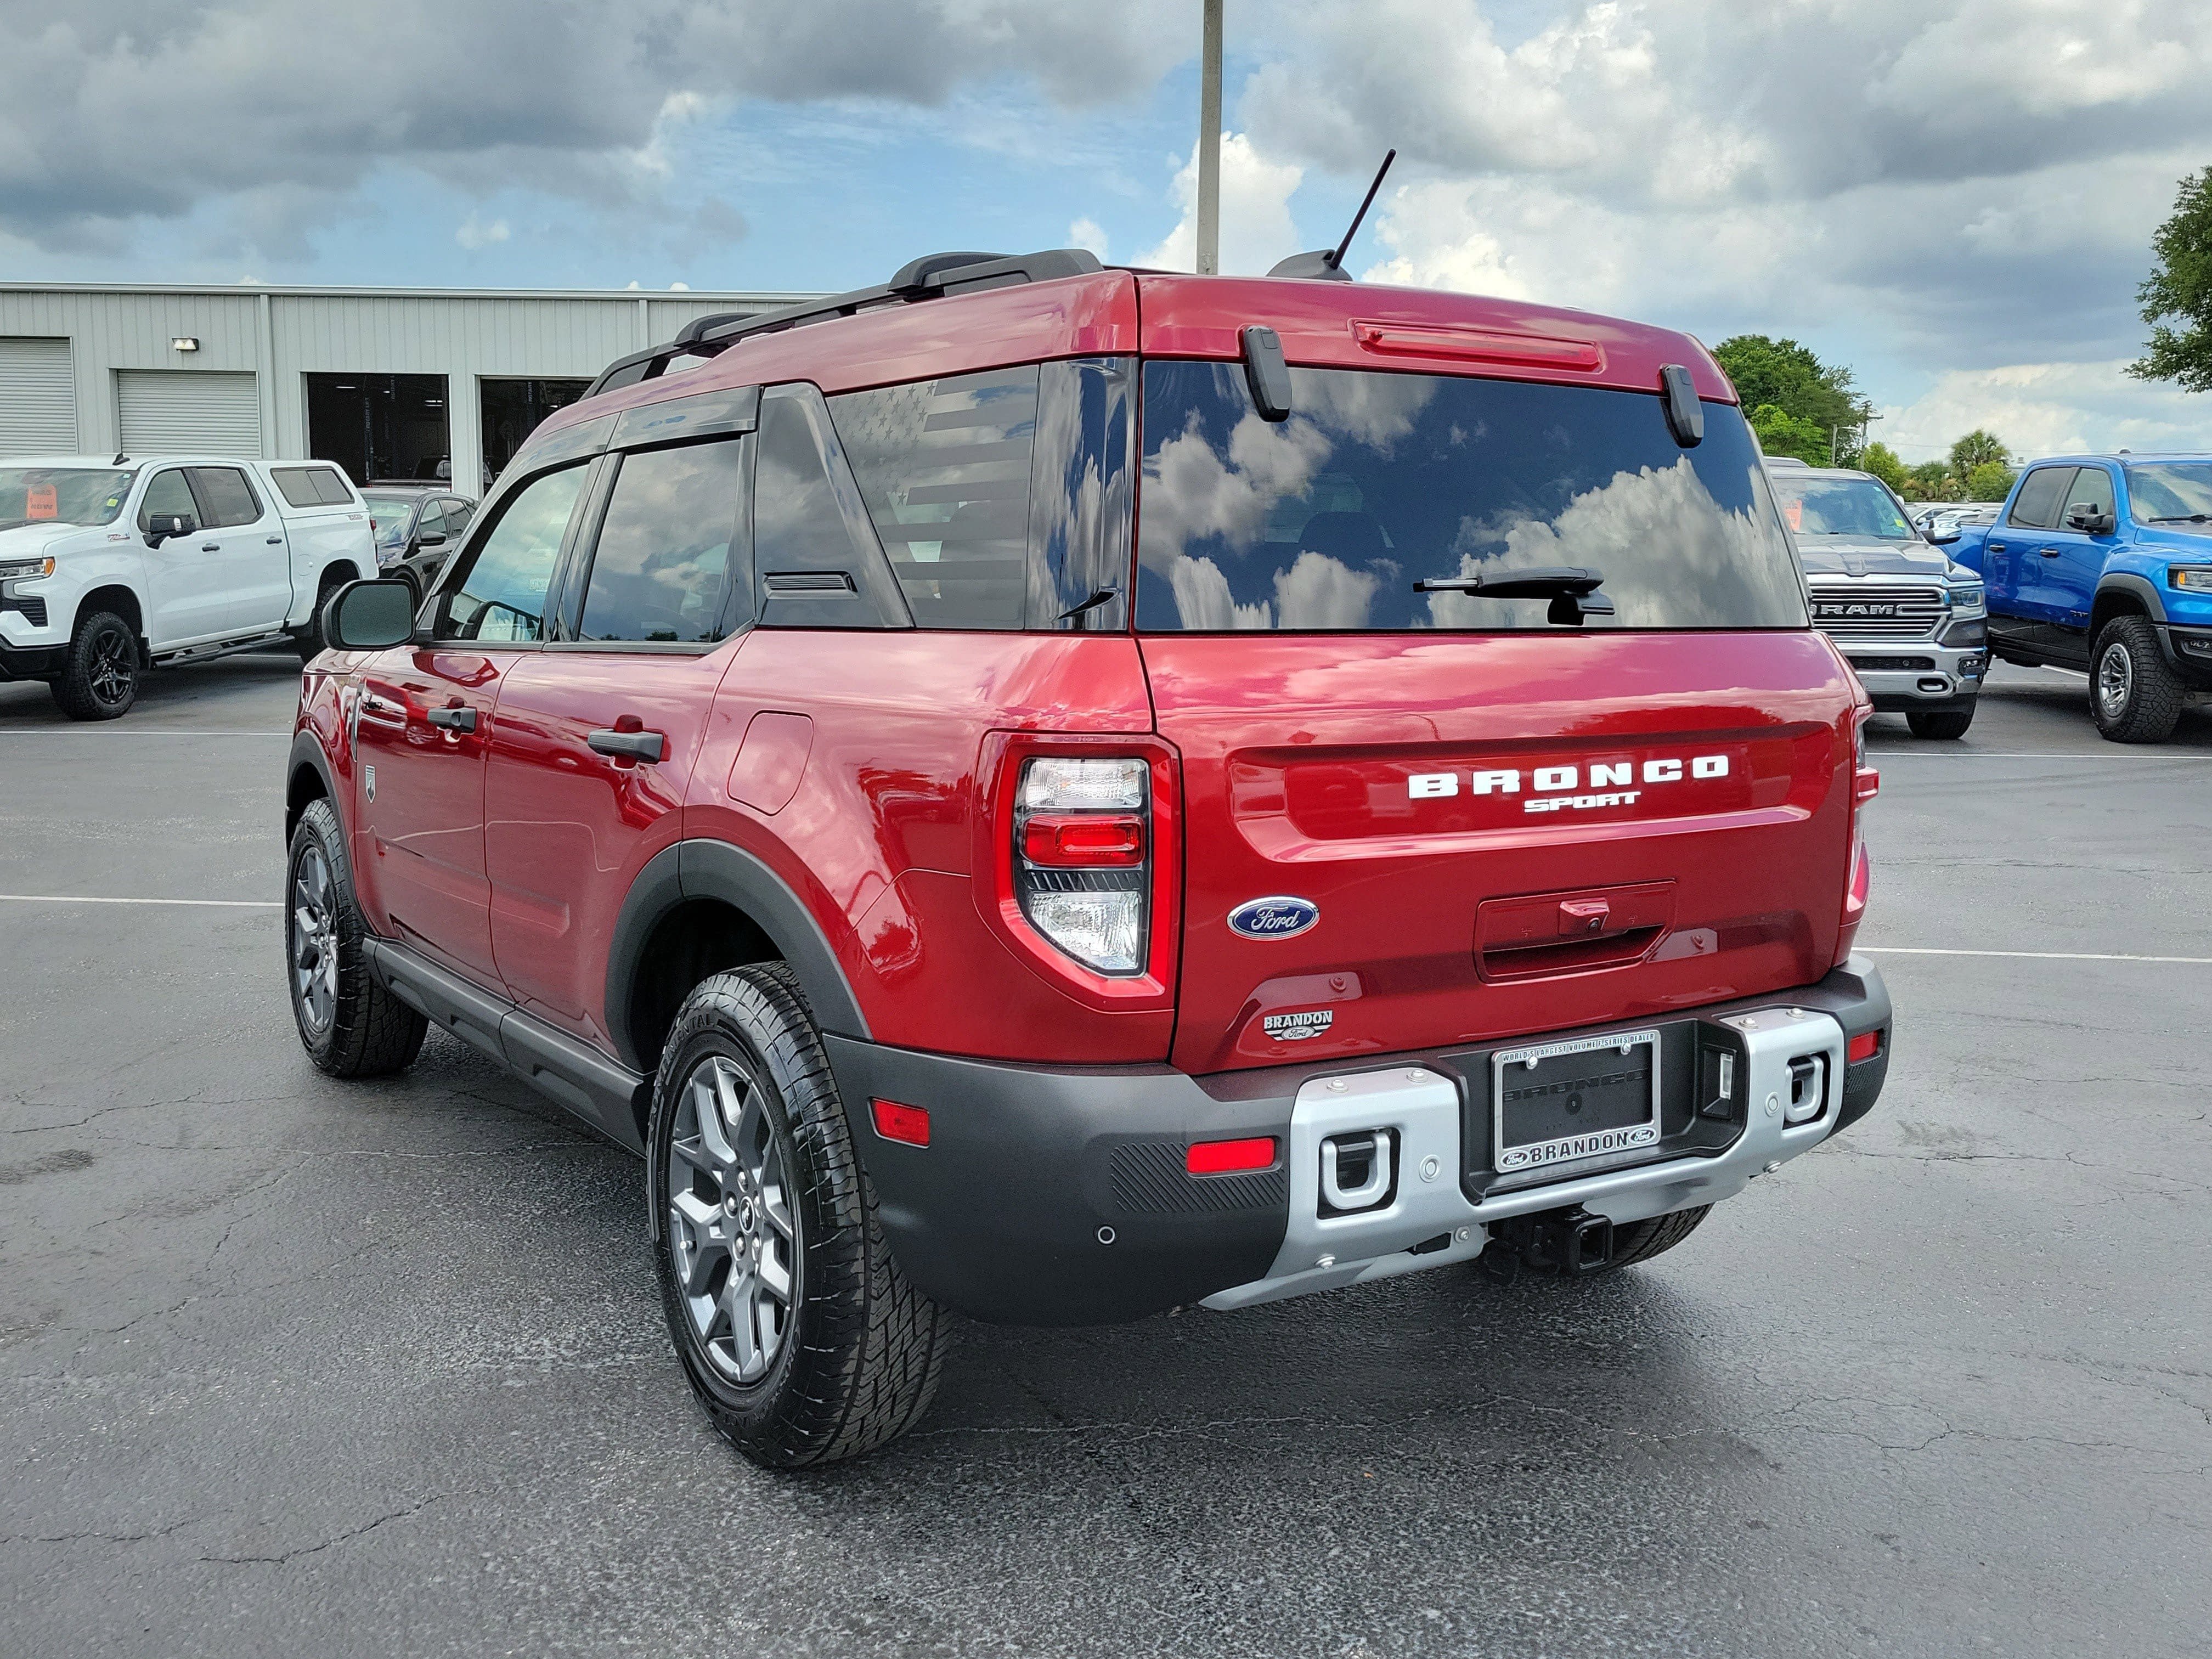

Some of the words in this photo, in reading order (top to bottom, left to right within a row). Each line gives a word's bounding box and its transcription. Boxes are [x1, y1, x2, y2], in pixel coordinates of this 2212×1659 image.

[1821, 605, 1894, 615] RAM
[1408, 755, 1729, 799] BRONCO
[1524, 792, 1641, 812] SPORT
[1251, 906, 1300, 930] Ford
[1264, 1011, 1332, 1029] BRANDON
[1289, 1028, 1309, 1038] Ford
[1502, 1050, 1534, 1062] WORLD'S
[1536, 1046, 1567, 1057] LARGEST
[1568, 1041, 1596, 1052] VOLUME
[1597, 1036, 1628, 1047] F-SERIES
[1630, 1033, 1655, 1043] DEALER
[1530, 1131, 1628, 1164] BRANDON
